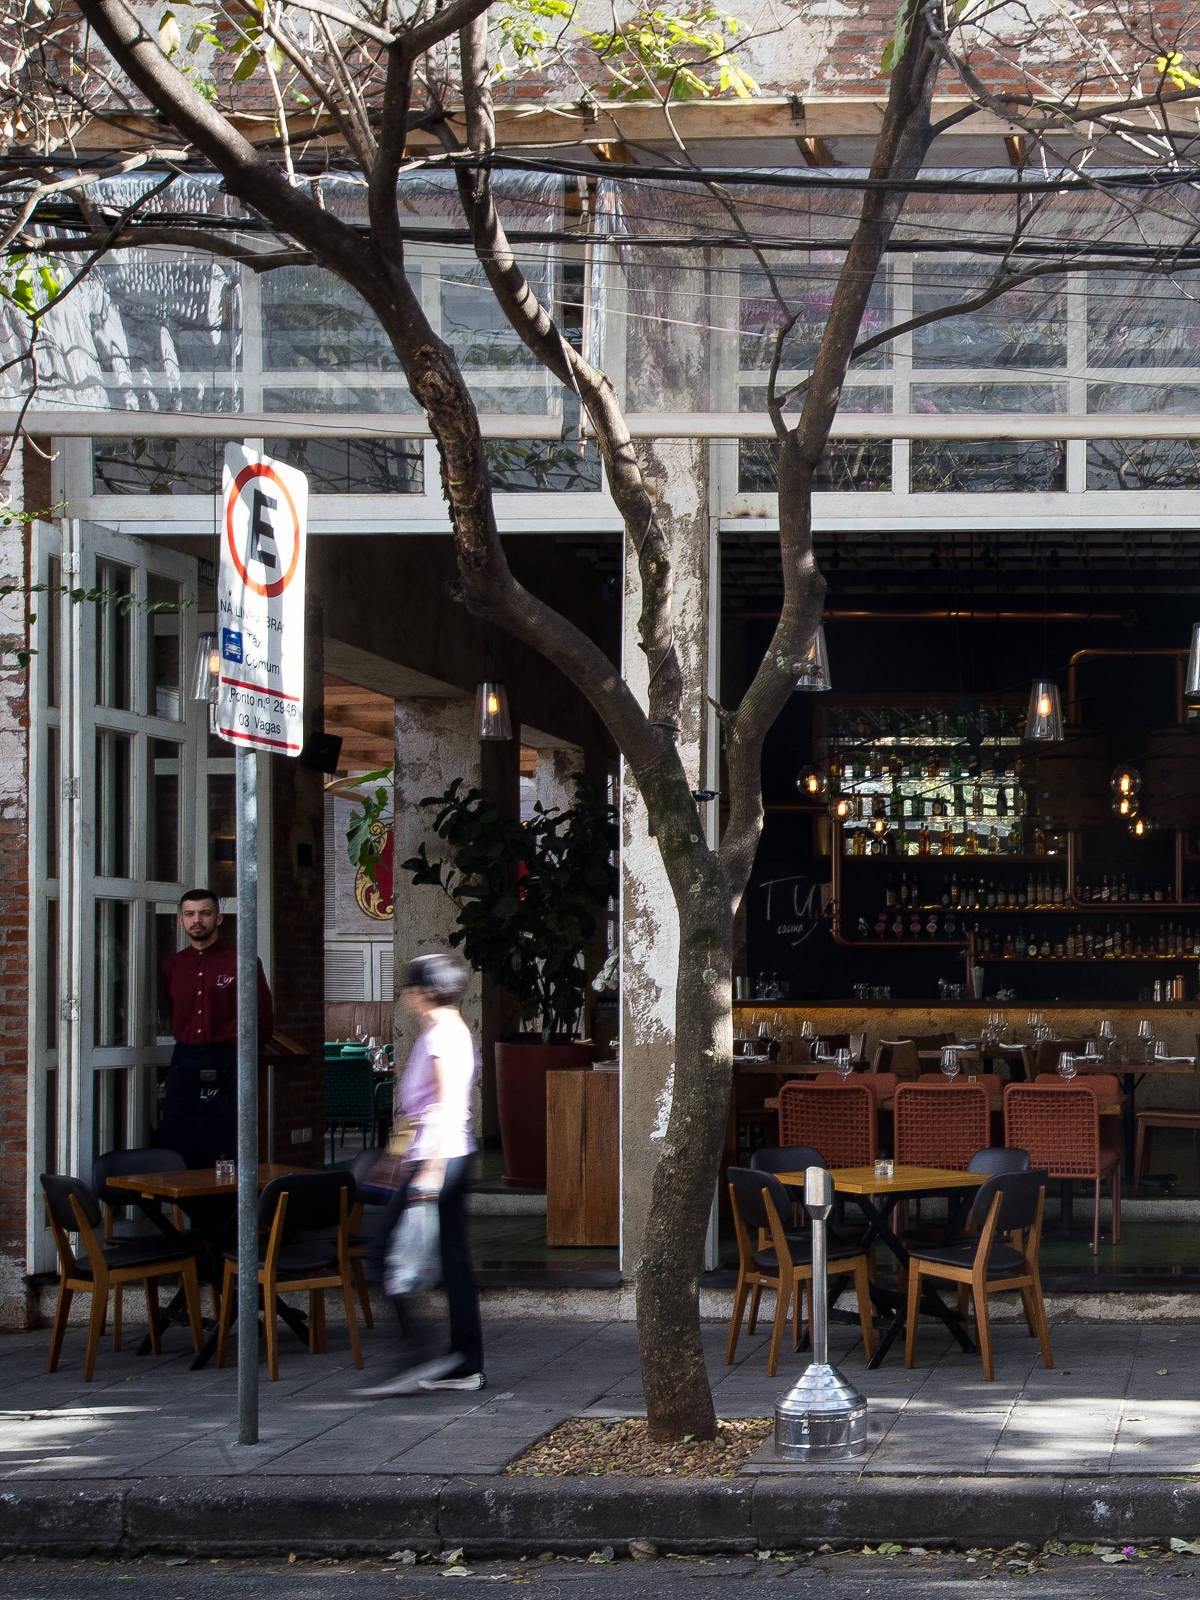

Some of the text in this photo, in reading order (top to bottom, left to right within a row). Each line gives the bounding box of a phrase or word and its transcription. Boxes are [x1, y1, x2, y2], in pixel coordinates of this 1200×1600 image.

[251, 488, 277, 569] E
[220, 599, 233, 615] NA
[246, 653, 280, 675] Comum
[230, 687, 255, 706] Ponto
[239, 713, 281, 735] 03 Vagas
